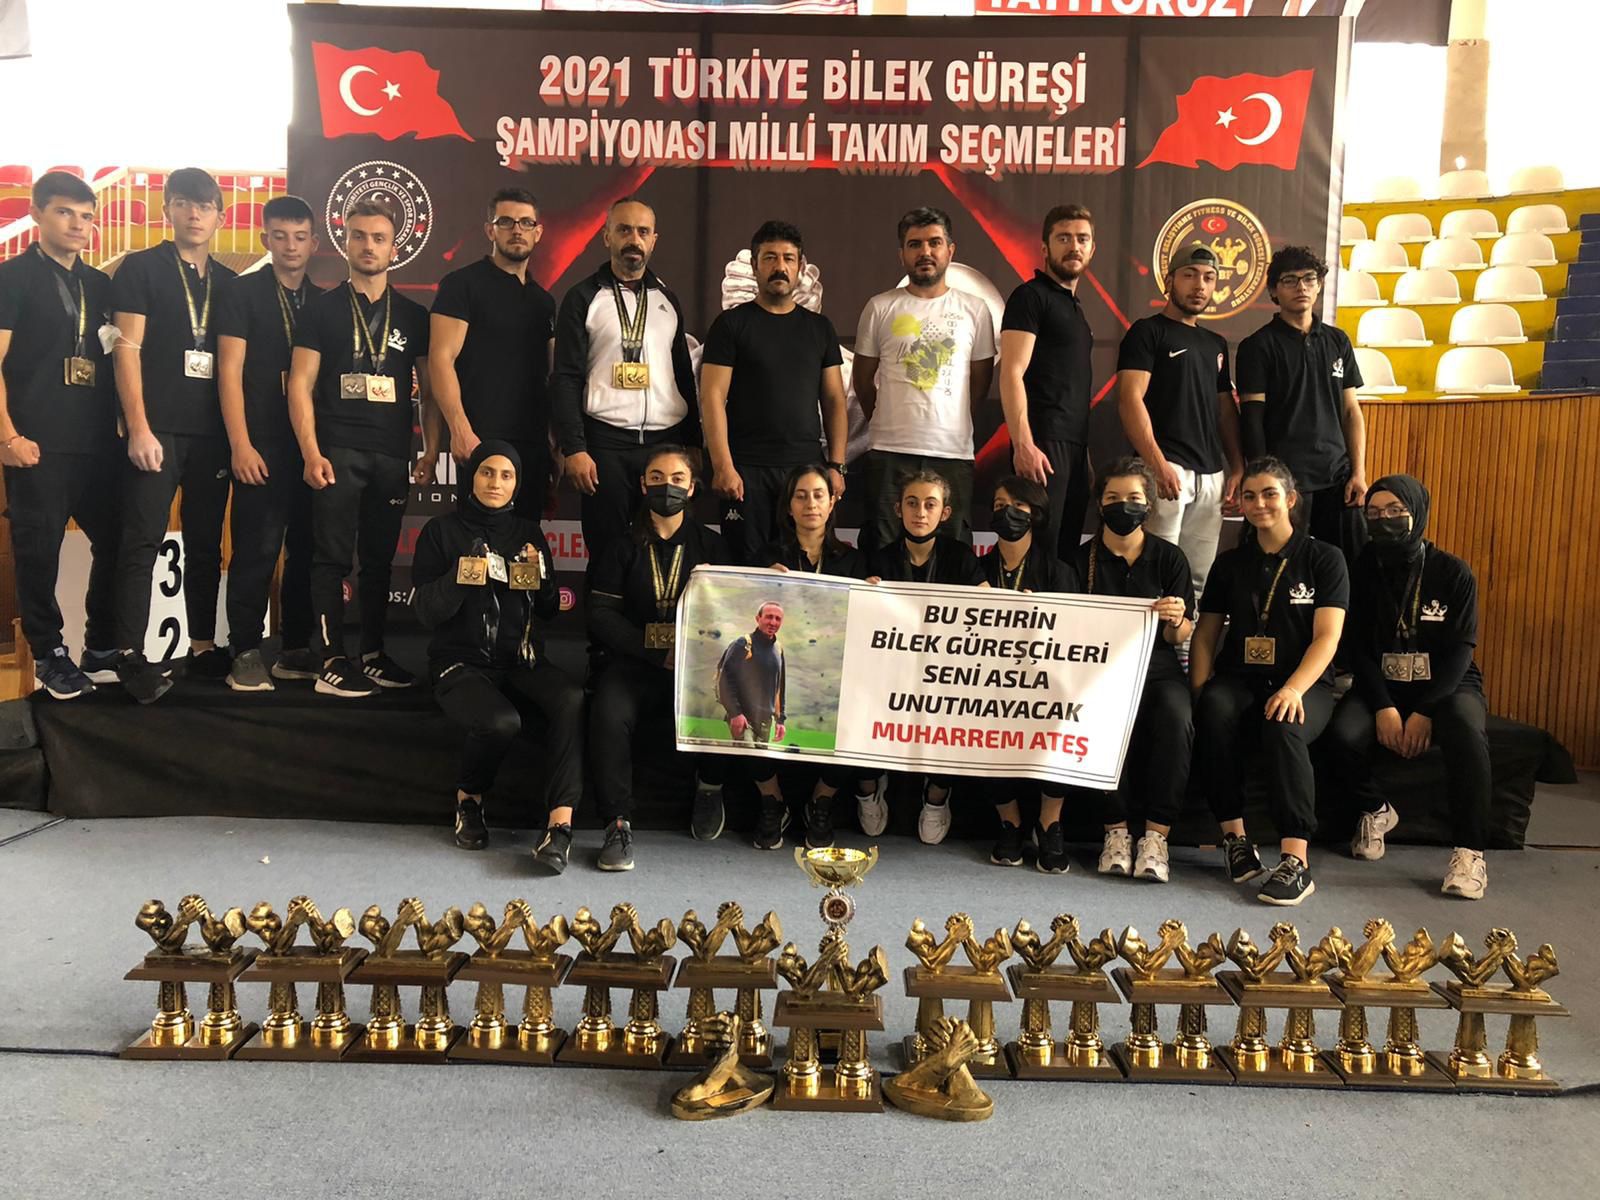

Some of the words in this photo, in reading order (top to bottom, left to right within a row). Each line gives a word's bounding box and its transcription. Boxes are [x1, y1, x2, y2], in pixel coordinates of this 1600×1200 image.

[539, 55, 630, 97] 2021
[648, 47, 808, 100] TÜRKİYE
[823, 49, 933, 101] BİLEK
[946, 50, 1087, 115] GÜREŞİ
[495, 109, 716, 166] ŞAMPİYONASI
[729, 112, 816, 161] MİLLİ
[827, 122, 928, 163] TAKIM
[939, 117, 1126, 175] SEÇMELERİ
[398, 191, 407, 200] VE
[404, 198, 413, 218] SPOR
[1226, 208, 1237, 218] VE
[159, 539, 182, 597] 3
[924, 605, 959, 624] BU
[963, 606, 1057, 632] ŞEHRİN
[158, 616, 181, 661] 2
[871, 627, 942, 653] BİLEK
[946, 633, 1110, 665] GÜREŞÇİLERİ
[923, 663, 982, 686] SENİ
[984, 669, 1049, 689] ASLA
[888, 692, 1084, 722] UNUTMAYACAK
[872, 721, 1024, 749] MUHARREM
[1029, 731, 1089, 762] ATEŞ
